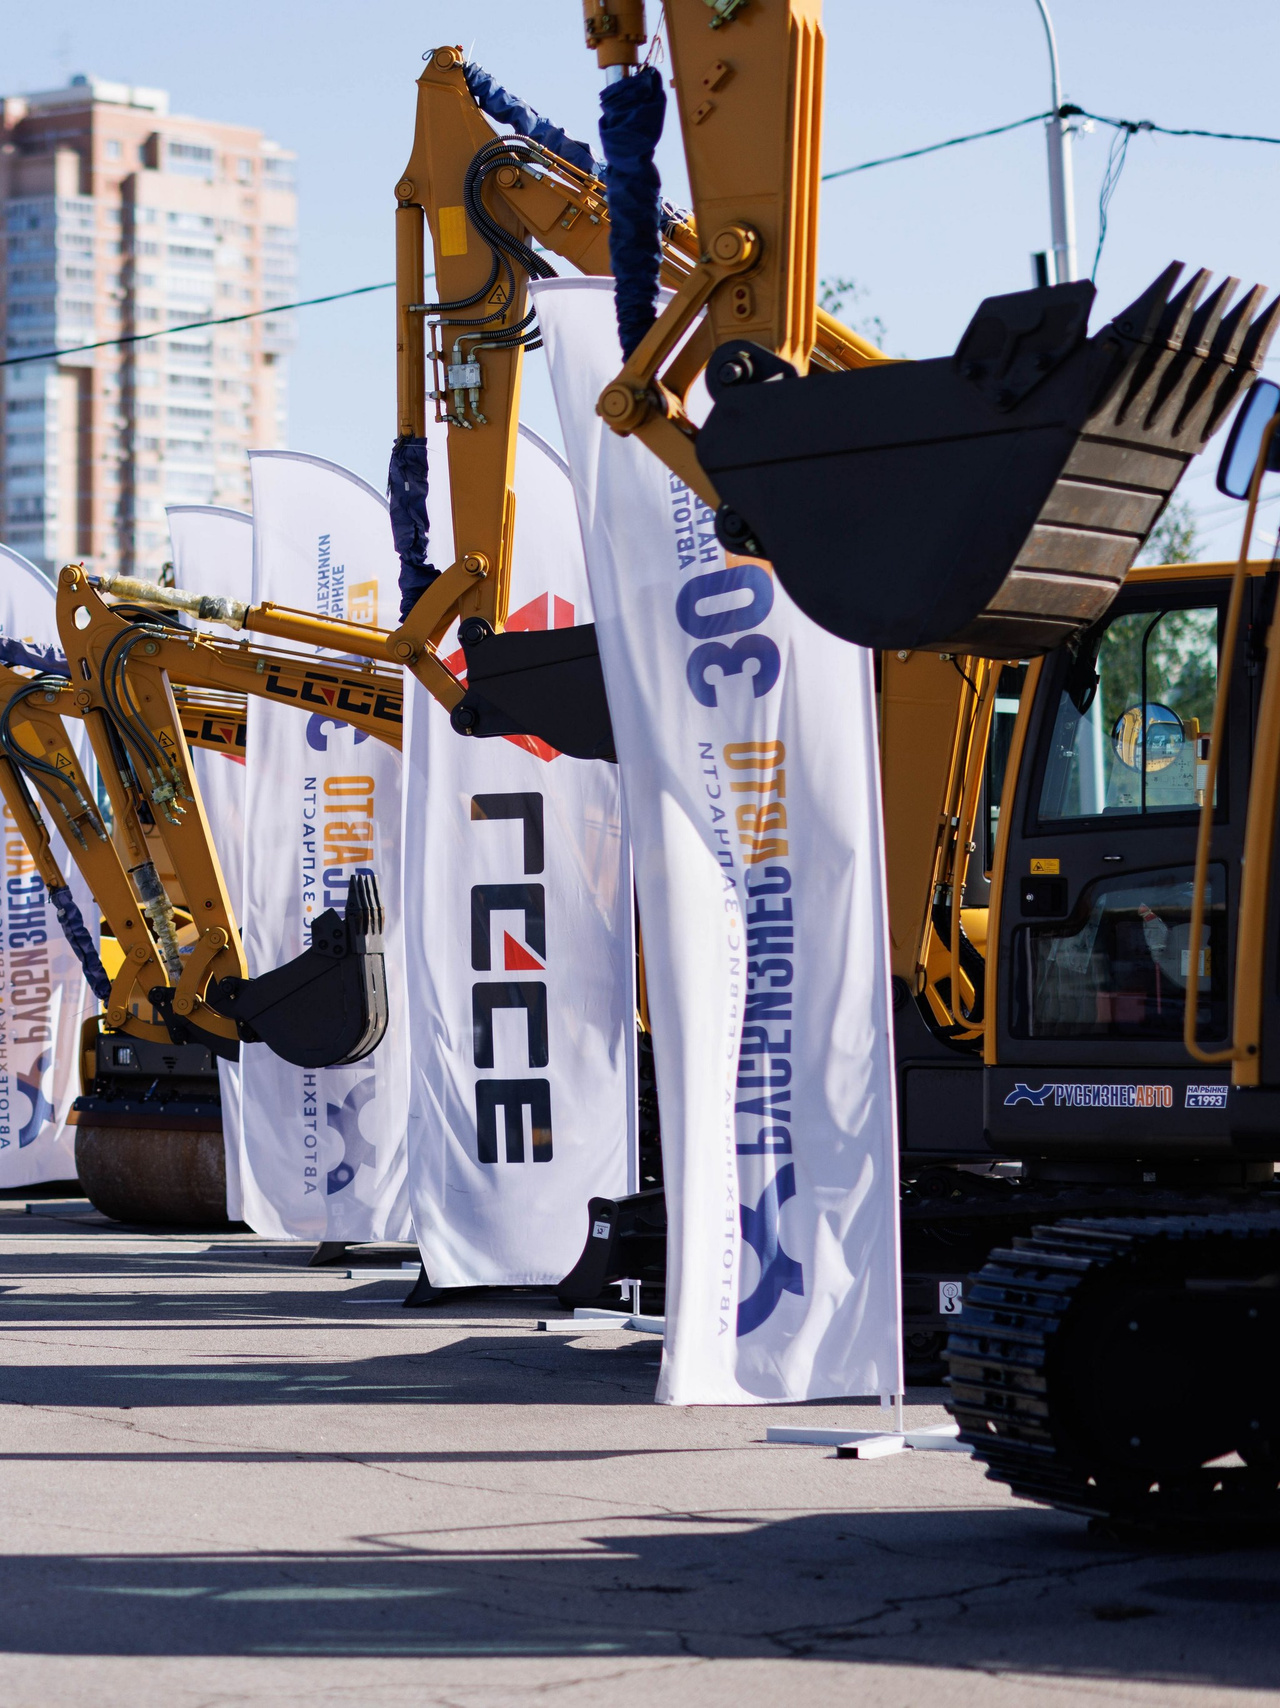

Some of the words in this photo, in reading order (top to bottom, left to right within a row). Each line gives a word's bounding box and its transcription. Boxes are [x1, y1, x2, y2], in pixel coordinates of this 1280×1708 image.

[1187, 1086, 1198, 1094] НА
[1199, 1086, 1228, 1094] РЫНКЕ
[1054, 1084, 1173, 1108] РУСБИЗНЕСАВТО
[1197, 1096, 1222, 1106] 1993
